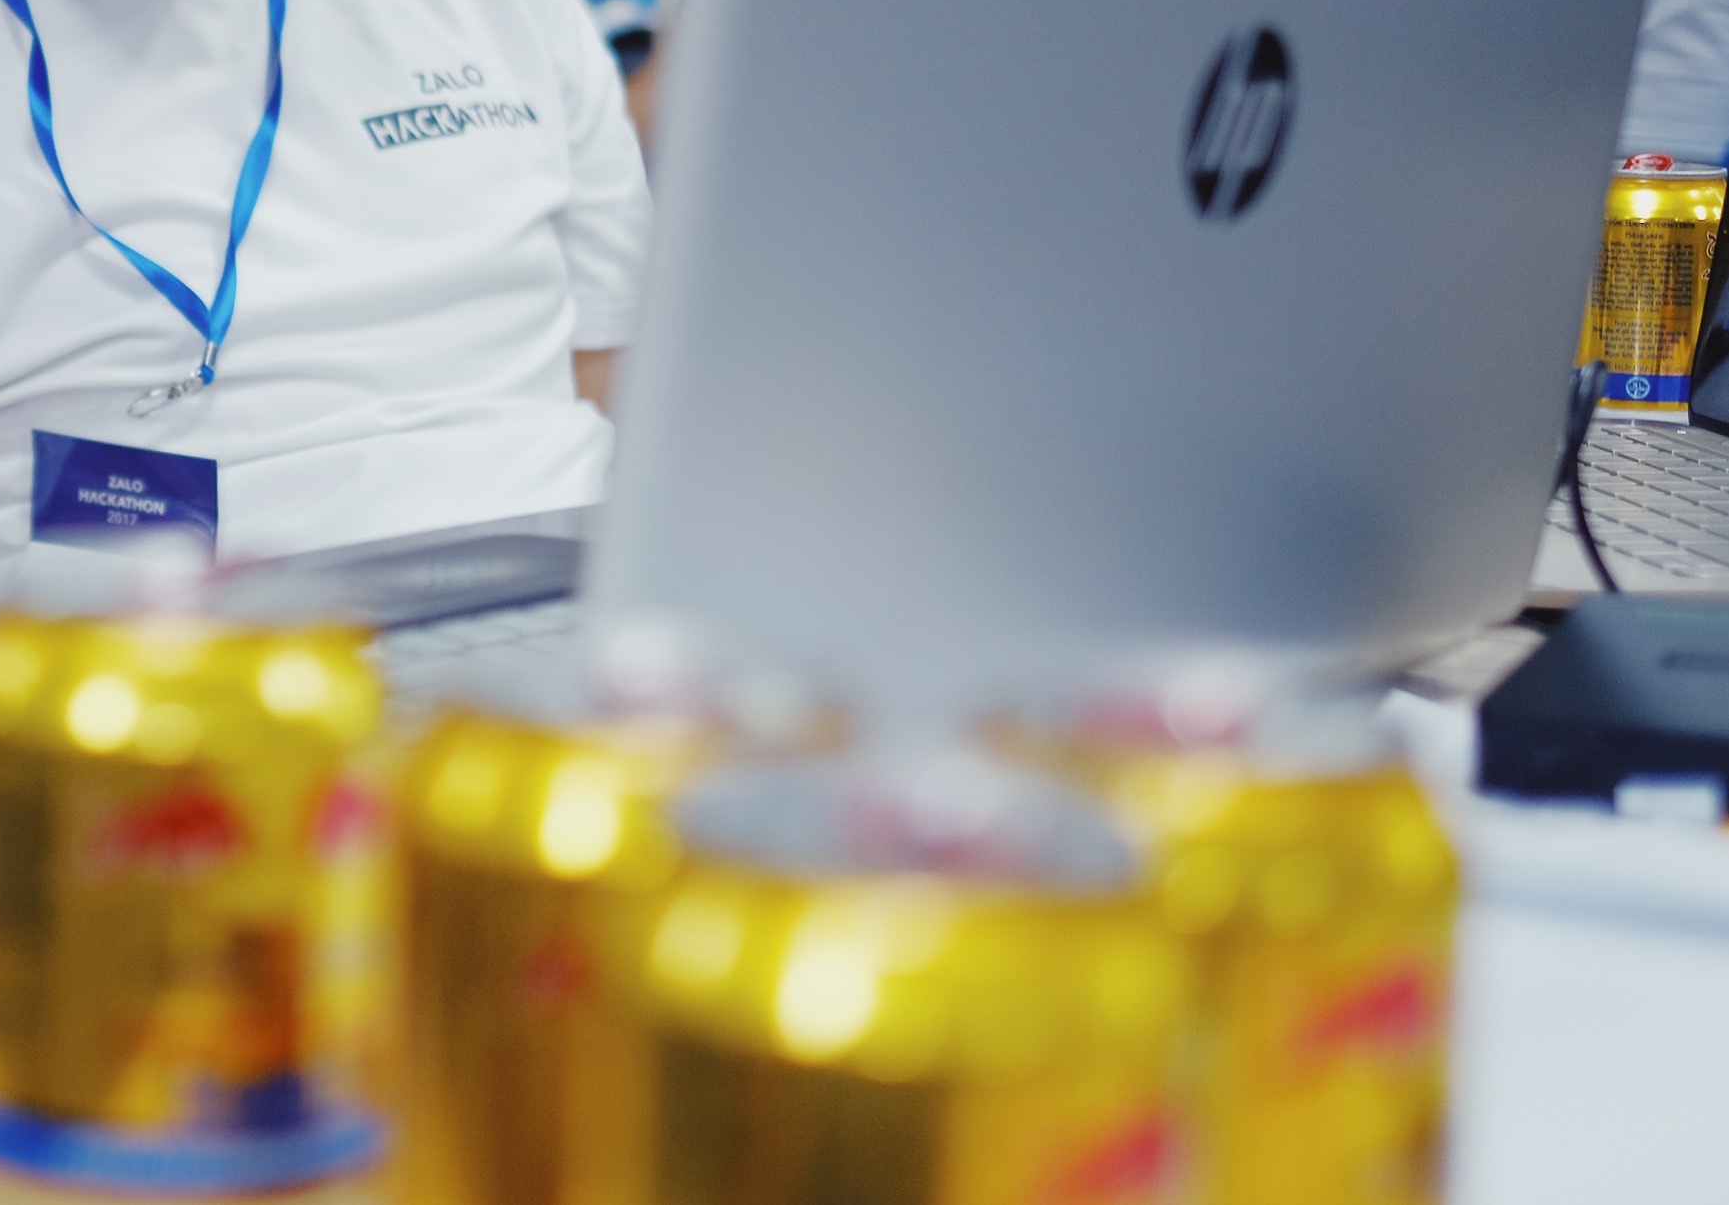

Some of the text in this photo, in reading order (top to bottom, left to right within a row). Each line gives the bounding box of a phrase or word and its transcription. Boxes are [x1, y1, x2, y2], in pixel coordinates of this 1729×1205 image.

[413, 64, 485, 95] ZALO
[362, 102, 539, 149] HACKATHON
[1187, 25, 1292, 220] hp
[108, 475, 144, 494] ZALO
[78, 488, 166, 515] HACKATHON
[107, 511, 138, 526] 2017
